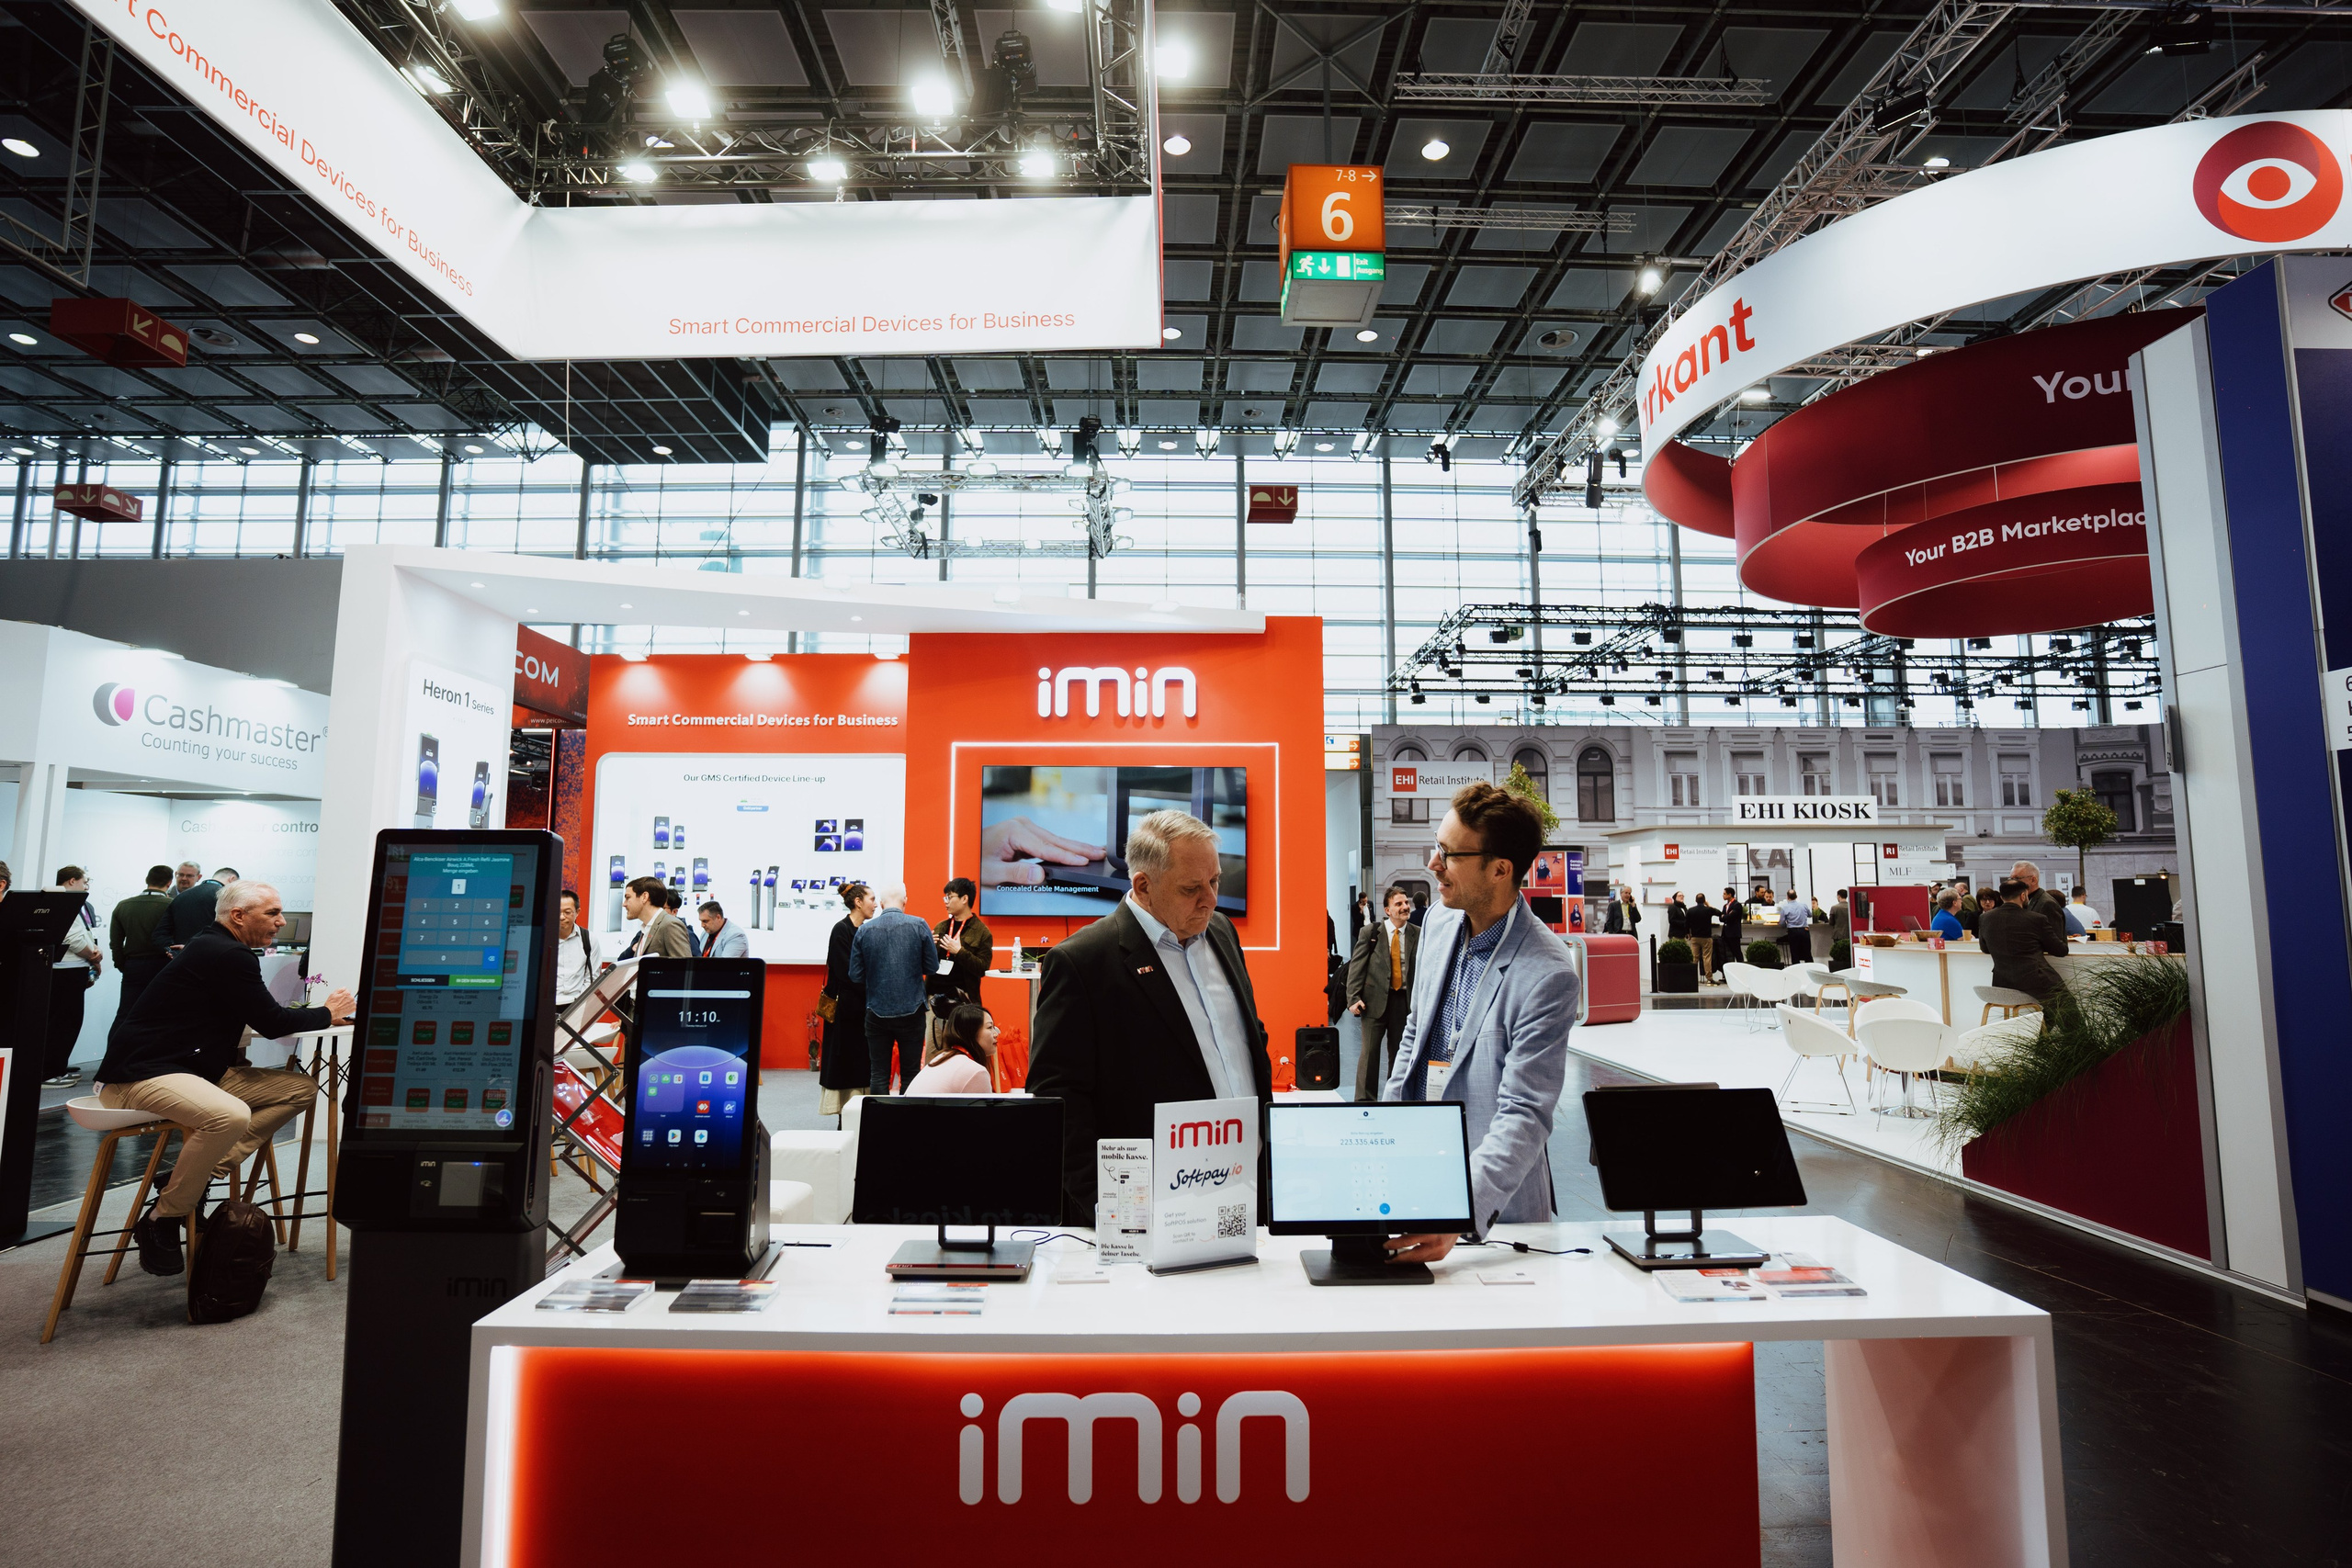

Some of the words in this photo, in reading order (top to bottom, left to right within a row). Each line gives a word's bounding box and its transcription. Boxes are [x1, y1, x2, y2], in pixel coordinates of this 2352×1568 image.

[146, 8, 295, 151] Commercial
[301, 138, 376, 218] Devices
[381, 207, 404, 239] for
[408, 230, 472, 297] Business
[1336, 169, 1357, 182] 7-8
[1321, 191, 1354, 242] 6
[1356, 266, 1384, 276] Ausgang
[669, 318, 729, 334] Smart
[735, 316, 855, 333] Commercial
[863, 314, 943, 333] Devices
[949, 313, 978, 330] for
[983, 310, 1075, 329] Business
[1905, 542, 1946, 566] Your
[1951, 528, 1995, 553] B2B
[423, 678, 462, 705] Heron
[465, 692, 470, 707] 1
[471, 699, 494, 715] Series
[1038, 667, 1196, 717] imin
[143, 694, 320, 753] Cashmaster
[628, 714, 669, 726] Smart
[672, 714, 753, 727] Commercial
[757, 714, 810, 727] Devices
[813, 714, 834, 726] for
[837, 714, 899, 727] Business
[141, 732, 210, 760] Counting
[216, 747, 246, 761] your
[250, 752, 298, 771] success
[723, 774, 761, 783] Certified
[792, 774, 826, 784] Line-up
[1396, 775, 1414, 784] EHI
[1419, 775, 1444, 785] Retail
[1739, 802, 1784, 819] EHI
[1792, 802, 1871, 819] KIOSK
[1885, 847, 1895, 855] RI
[1889, 867, 1912, 876] MLF
[1034, 885, 1053, 893] Cable
[1054, 886, 1100, 894] Management
[679, 1011, 717, 1022] 11:10
[1170, 1119, 1242, 1149] imin
[1170, 1162, 1243, 1190] Softpay.io
[1164, 1219, 1186, 1227] SoftPOS
[1187, 1217, 1207, 1225] solution
[447, 1277, 507, 1298] imin
[959, 1390, 1310, 1506] imin
